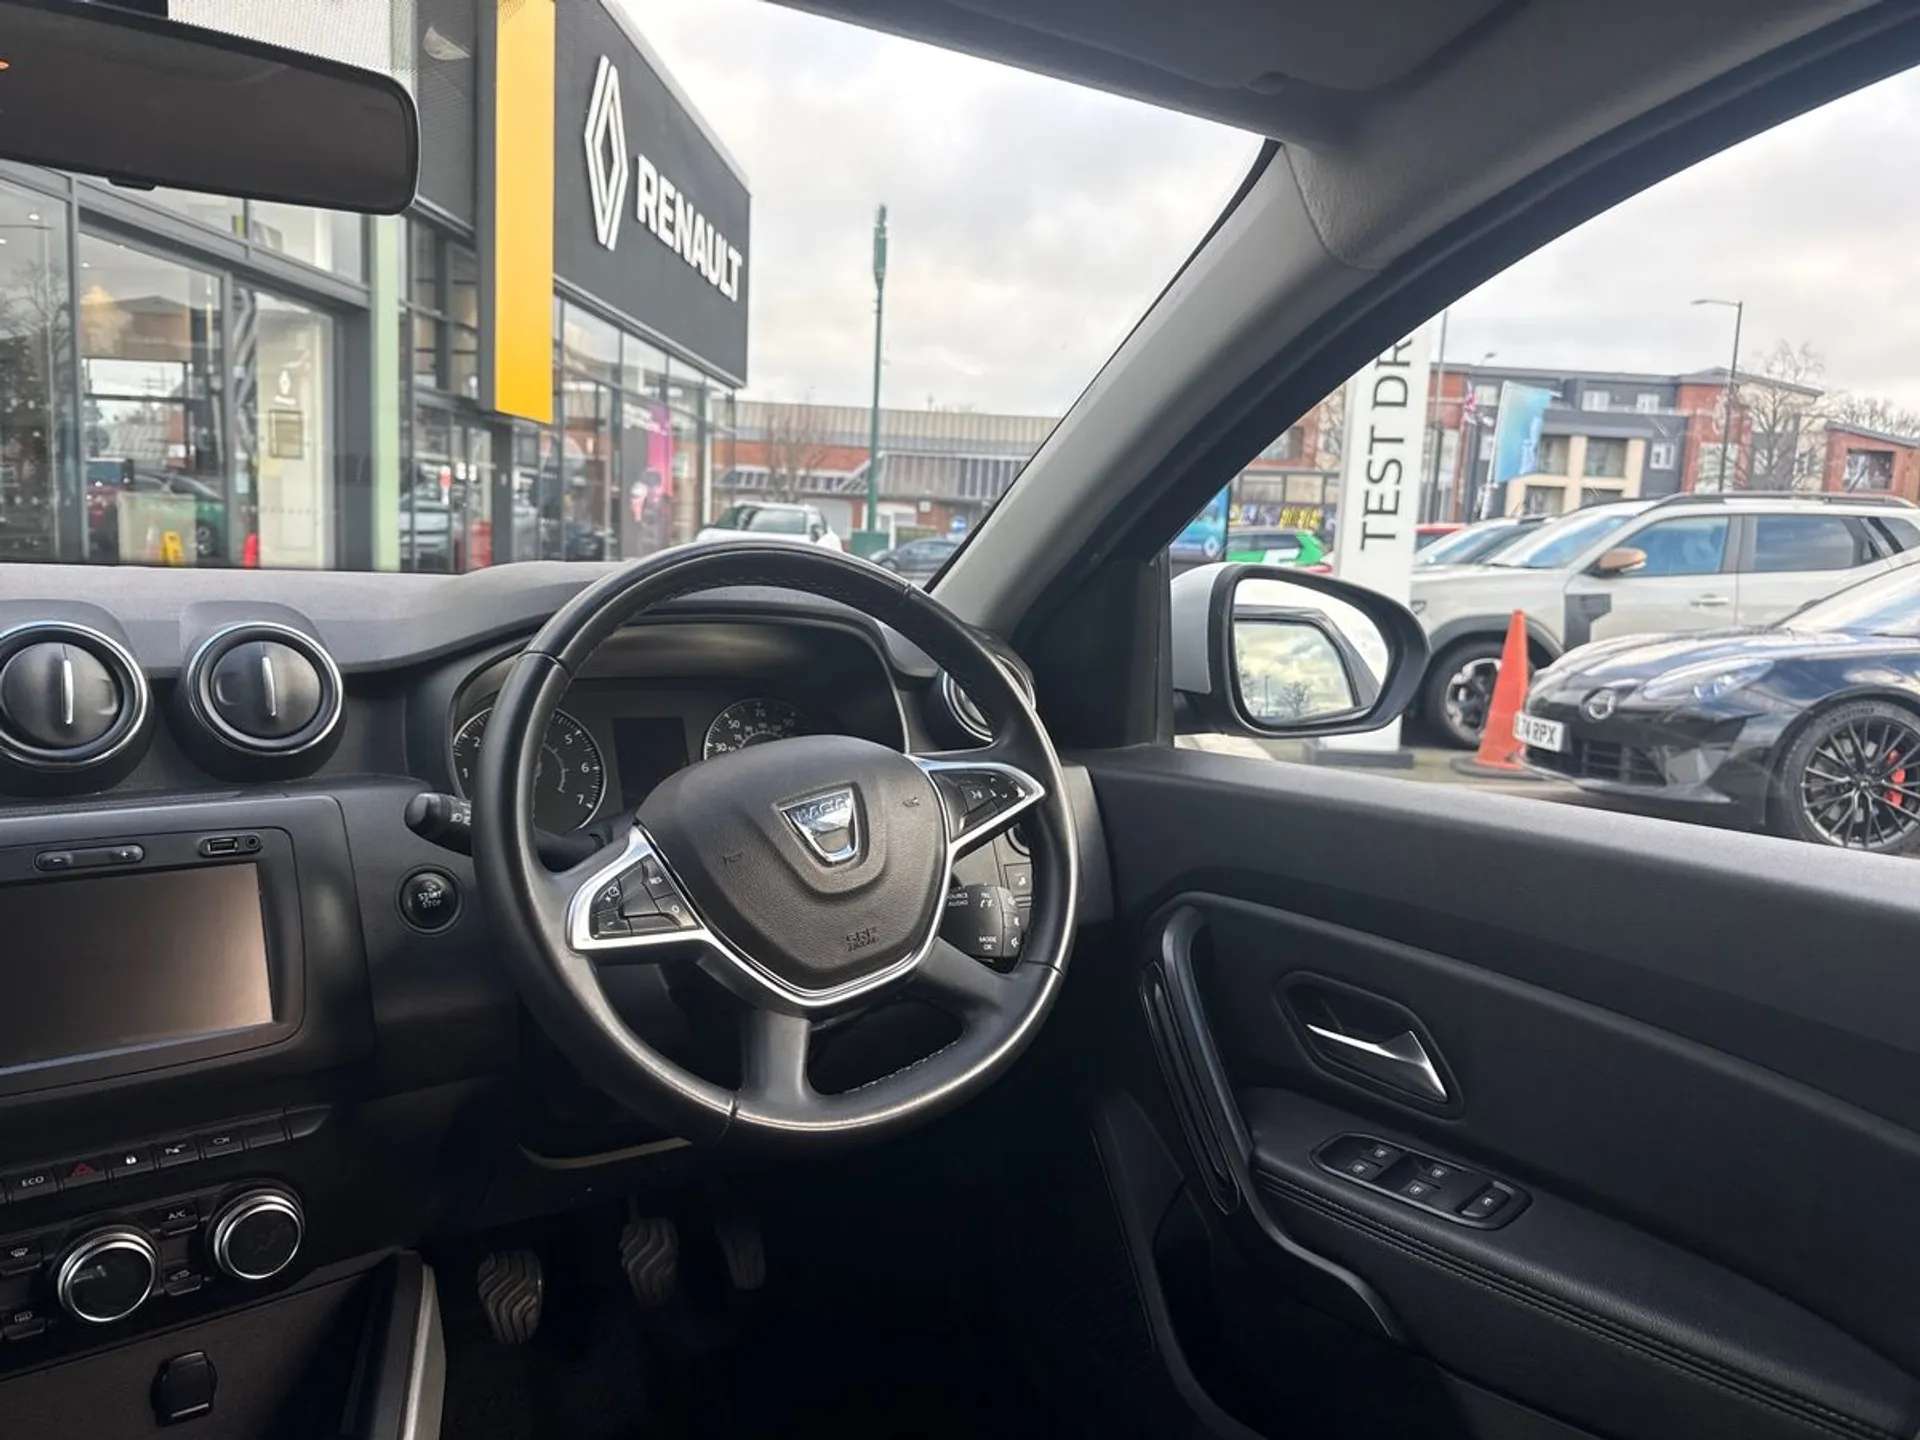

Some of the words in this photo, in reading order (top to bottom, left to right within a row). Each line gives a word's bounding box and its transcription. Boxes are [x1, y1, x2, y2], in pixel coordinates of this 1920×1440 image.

[637, 153, 743, 302] RENAULT
[1360, 425, 1405, 552] TEST
[728, 719, 740, 729] 50
[1533, 721, 1557, 745] RPX
[473, 735, 481, 748] 2
[564, 734, 573, 745] 5
[462, 767, 469, 778] 1
[580, 761, 590, 773] 6
[576, 793, 585, 805] 7
[21, 1175, 45, 1187] ECO
[168, 1210, 186, 1220] A/C
